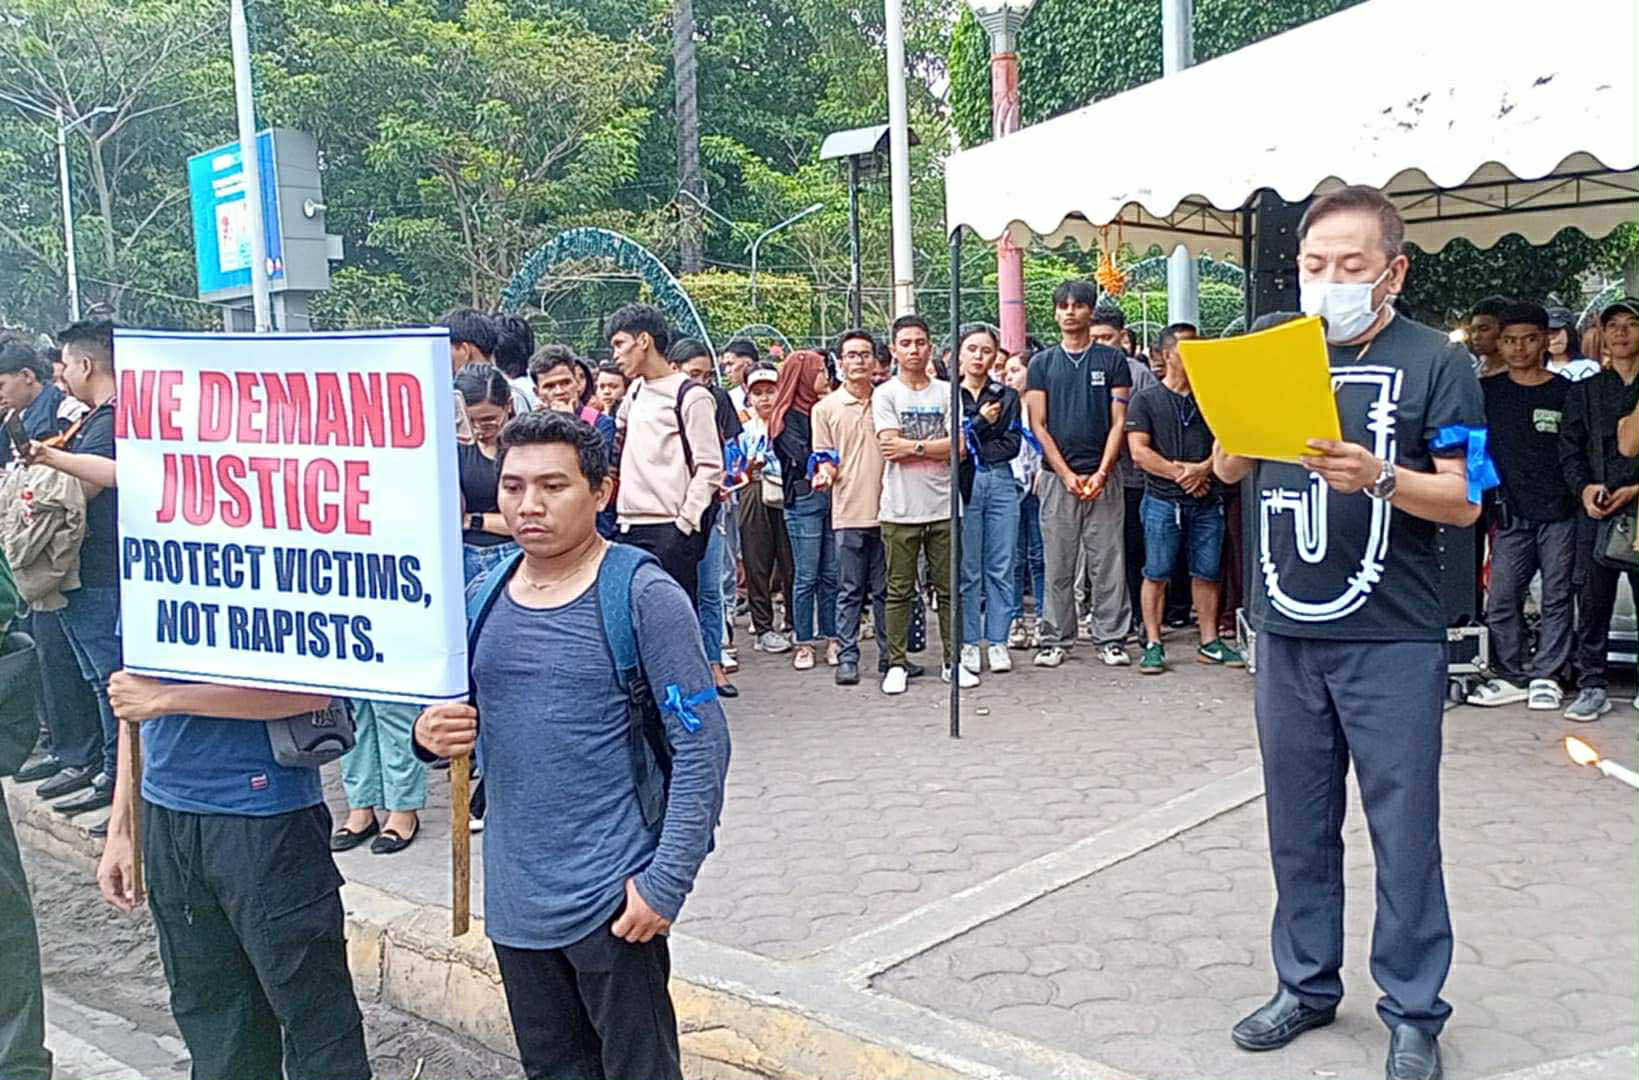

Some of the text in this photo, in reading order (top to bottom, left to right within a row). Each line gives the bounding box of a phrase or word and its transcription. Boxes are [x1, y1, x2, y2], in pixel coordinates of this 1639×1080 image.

[199, 371, 425, 448] DEMAND
[157, 453, 372, 536] JUSTICE
[123, 537, 432, 608] PROTECT VICTIMS,
[157, 599, 384, 663] NOT RAPISTS.
